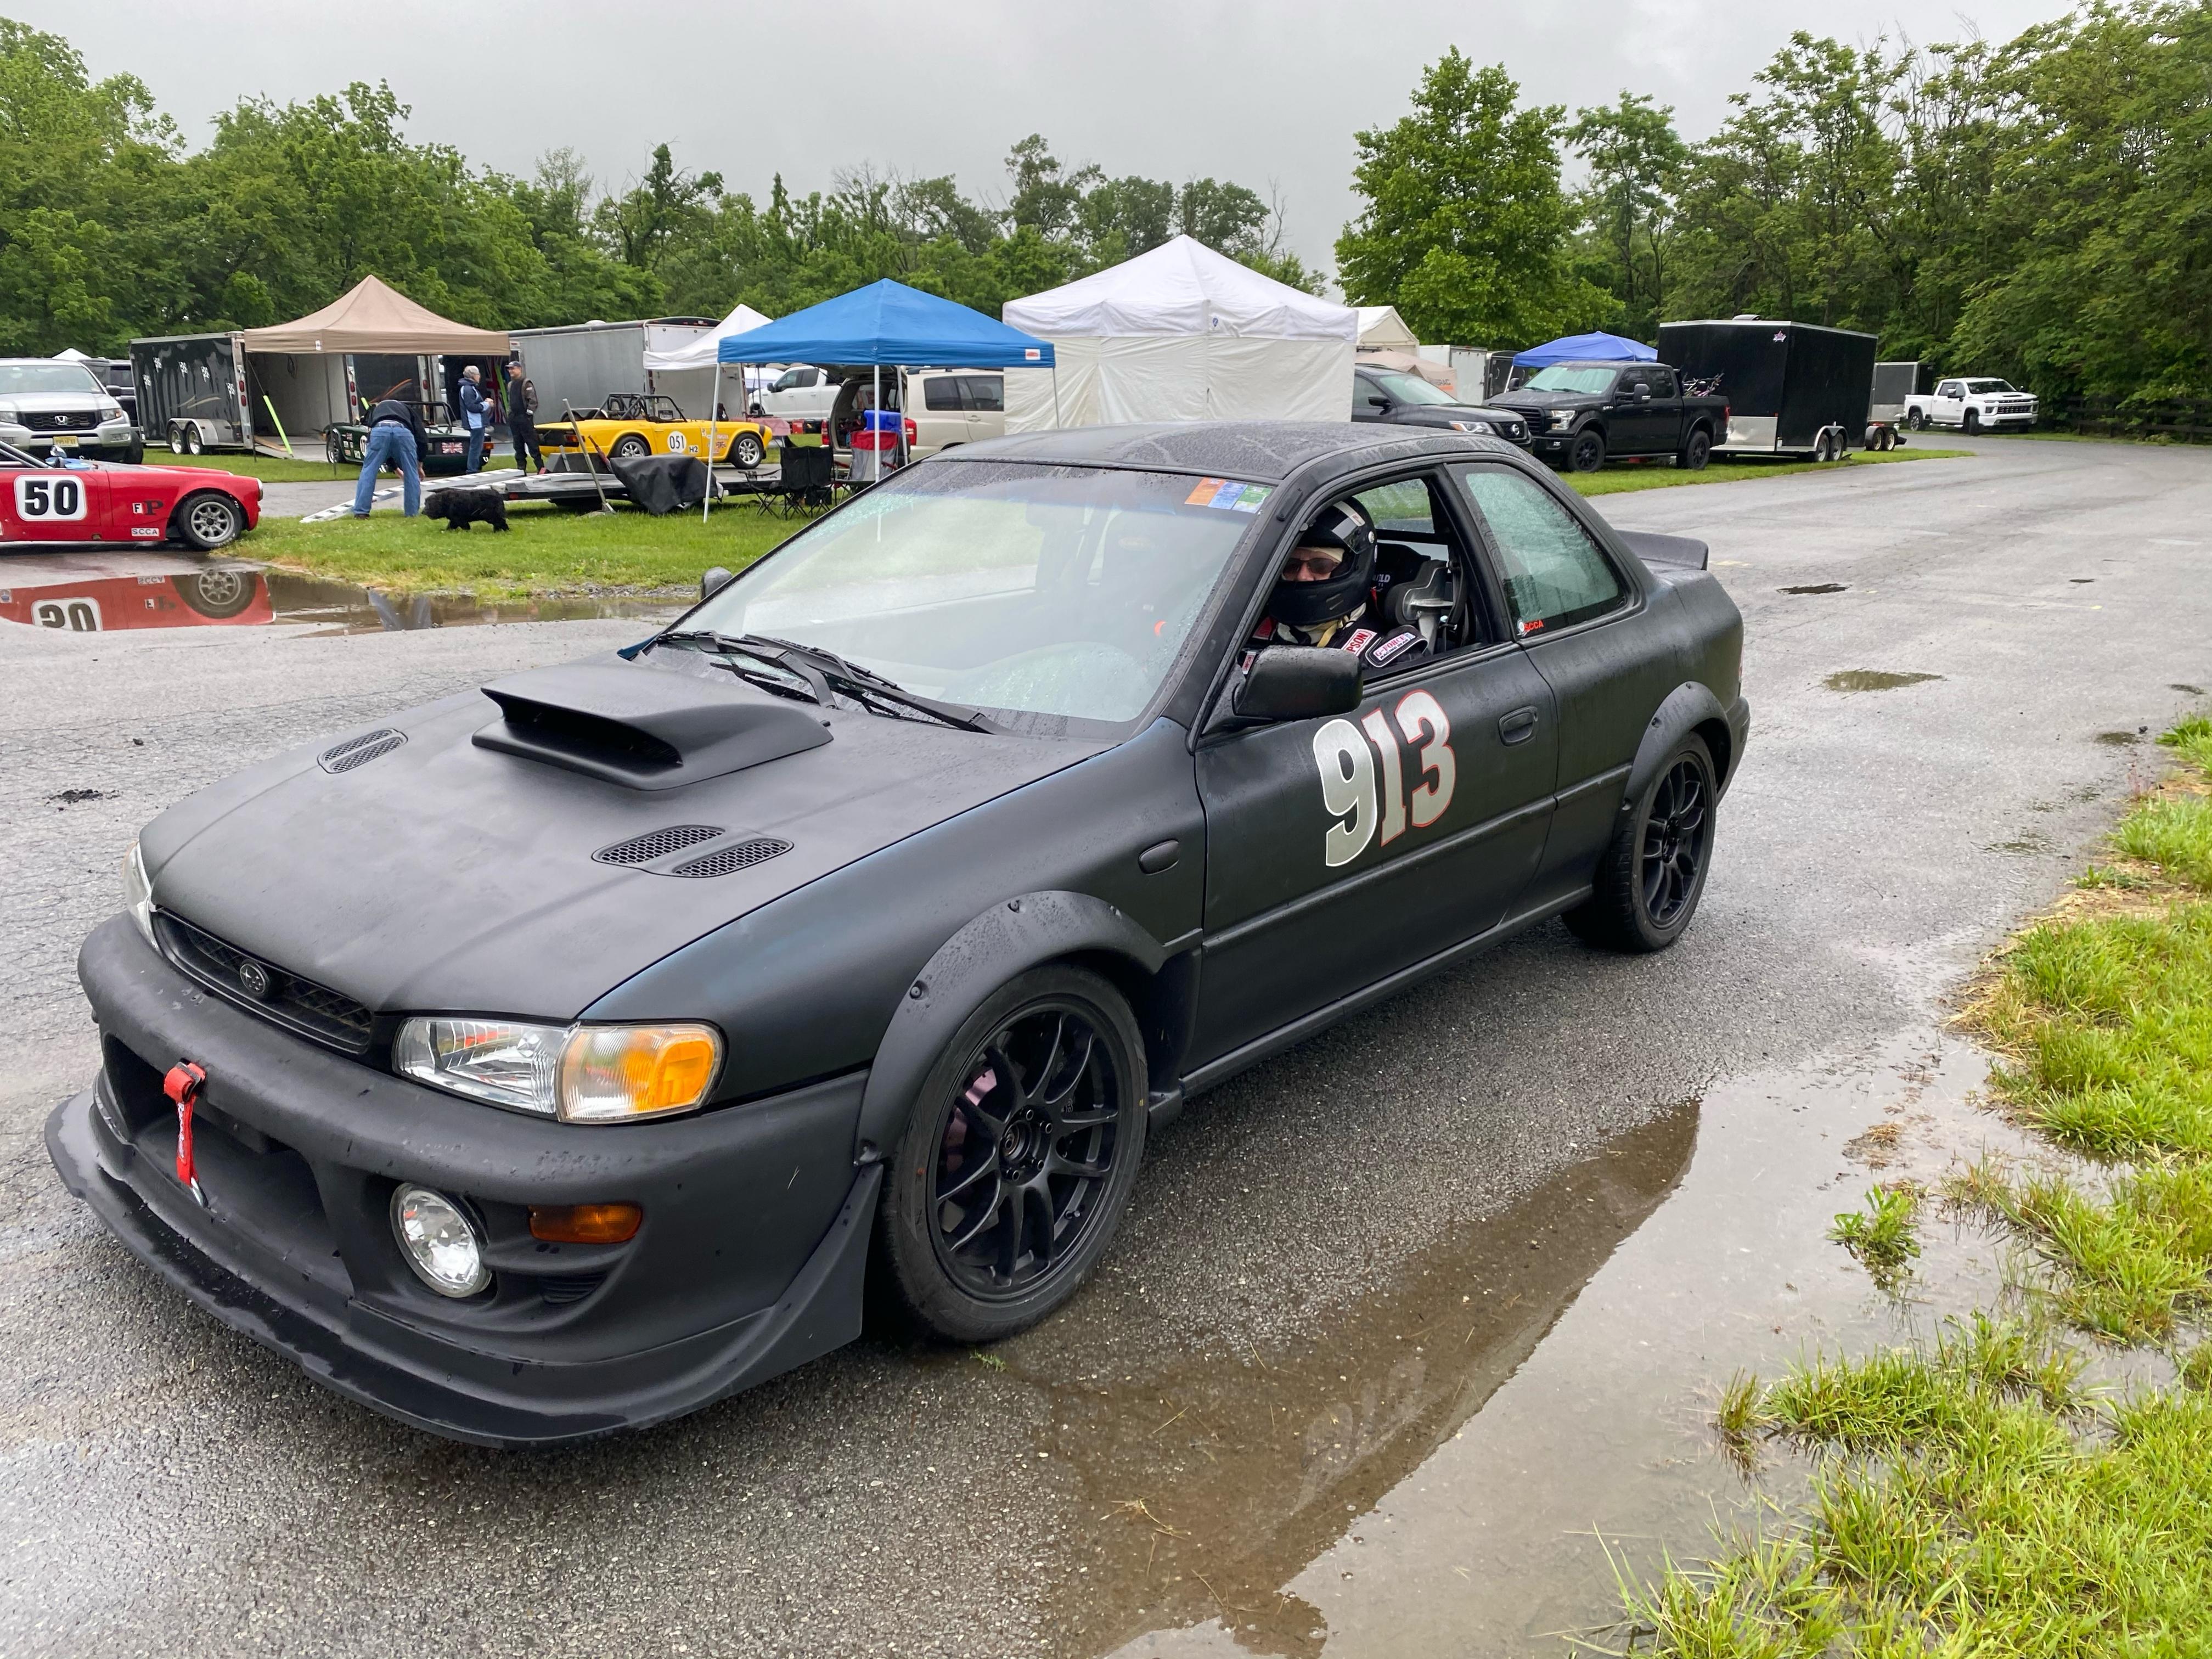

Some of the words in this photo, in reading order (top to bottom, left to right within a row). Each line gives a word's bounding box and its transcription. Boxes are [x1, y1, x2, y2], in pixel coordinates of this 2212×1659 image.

[669, 435, 684, 449] 051
[25, 480, 78, 516] 50
[1524, 619, 1544, 632] SCCA
[1346, 632, 1369, 653] PSON
[1375, 634, 1405, 657] G-FORCE
[1380, 646, 1397, 659] RACING
[1313, 689, 1456, 867] 913
